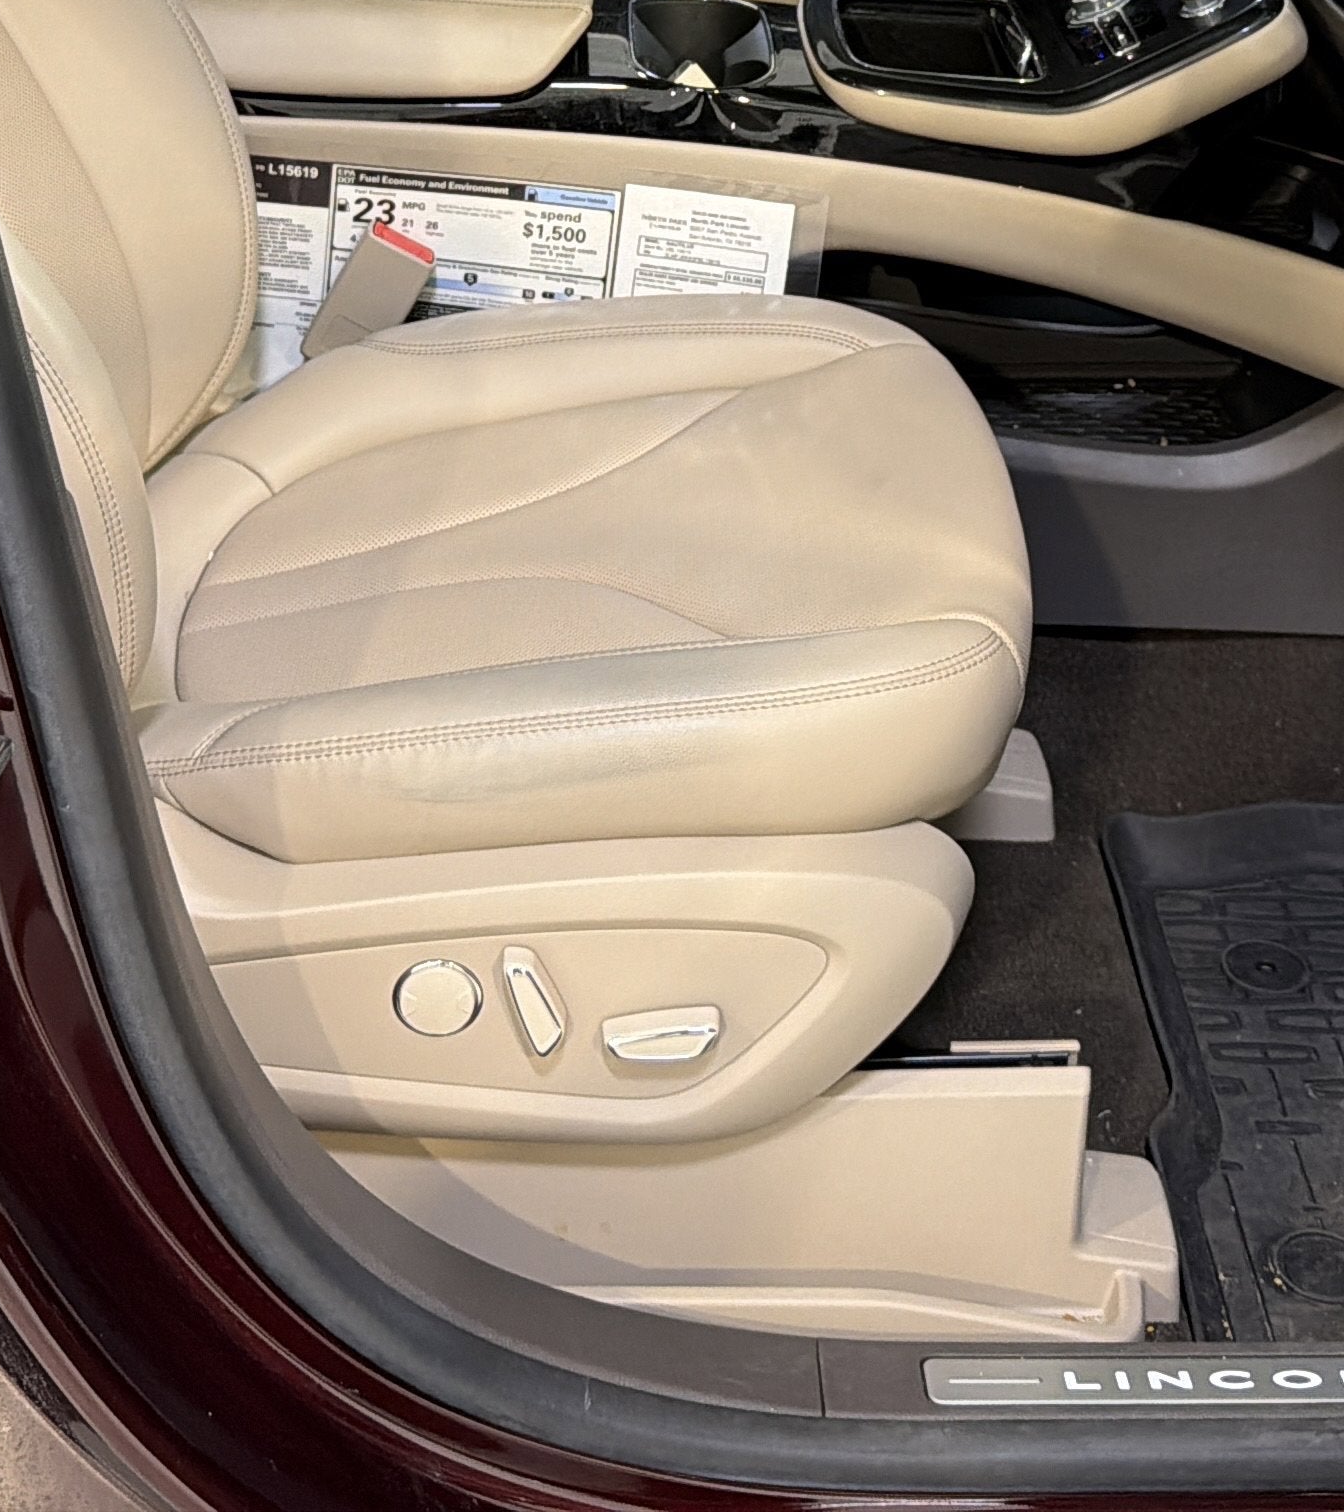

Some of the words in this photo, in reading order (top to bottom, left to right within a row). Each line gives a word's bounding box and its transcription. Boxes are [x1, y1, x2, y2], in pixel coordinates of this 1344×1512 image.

[359, 173, 380, 184] Fuel
[382, 175, 426, 188] Economy
[428, 181, 447, 189] and
[448, 181, 510, 196] Environment
[352, 197, 396, 225] 23
[402, 201, 426, 211] MPG
[540, 211, 582, 223] spend
[401, 218, 414, 228] 21
[425, 221, 439, 230] 26
[522, 221, 586, 244] $1,500
[467, 273, 474, 282] 5
